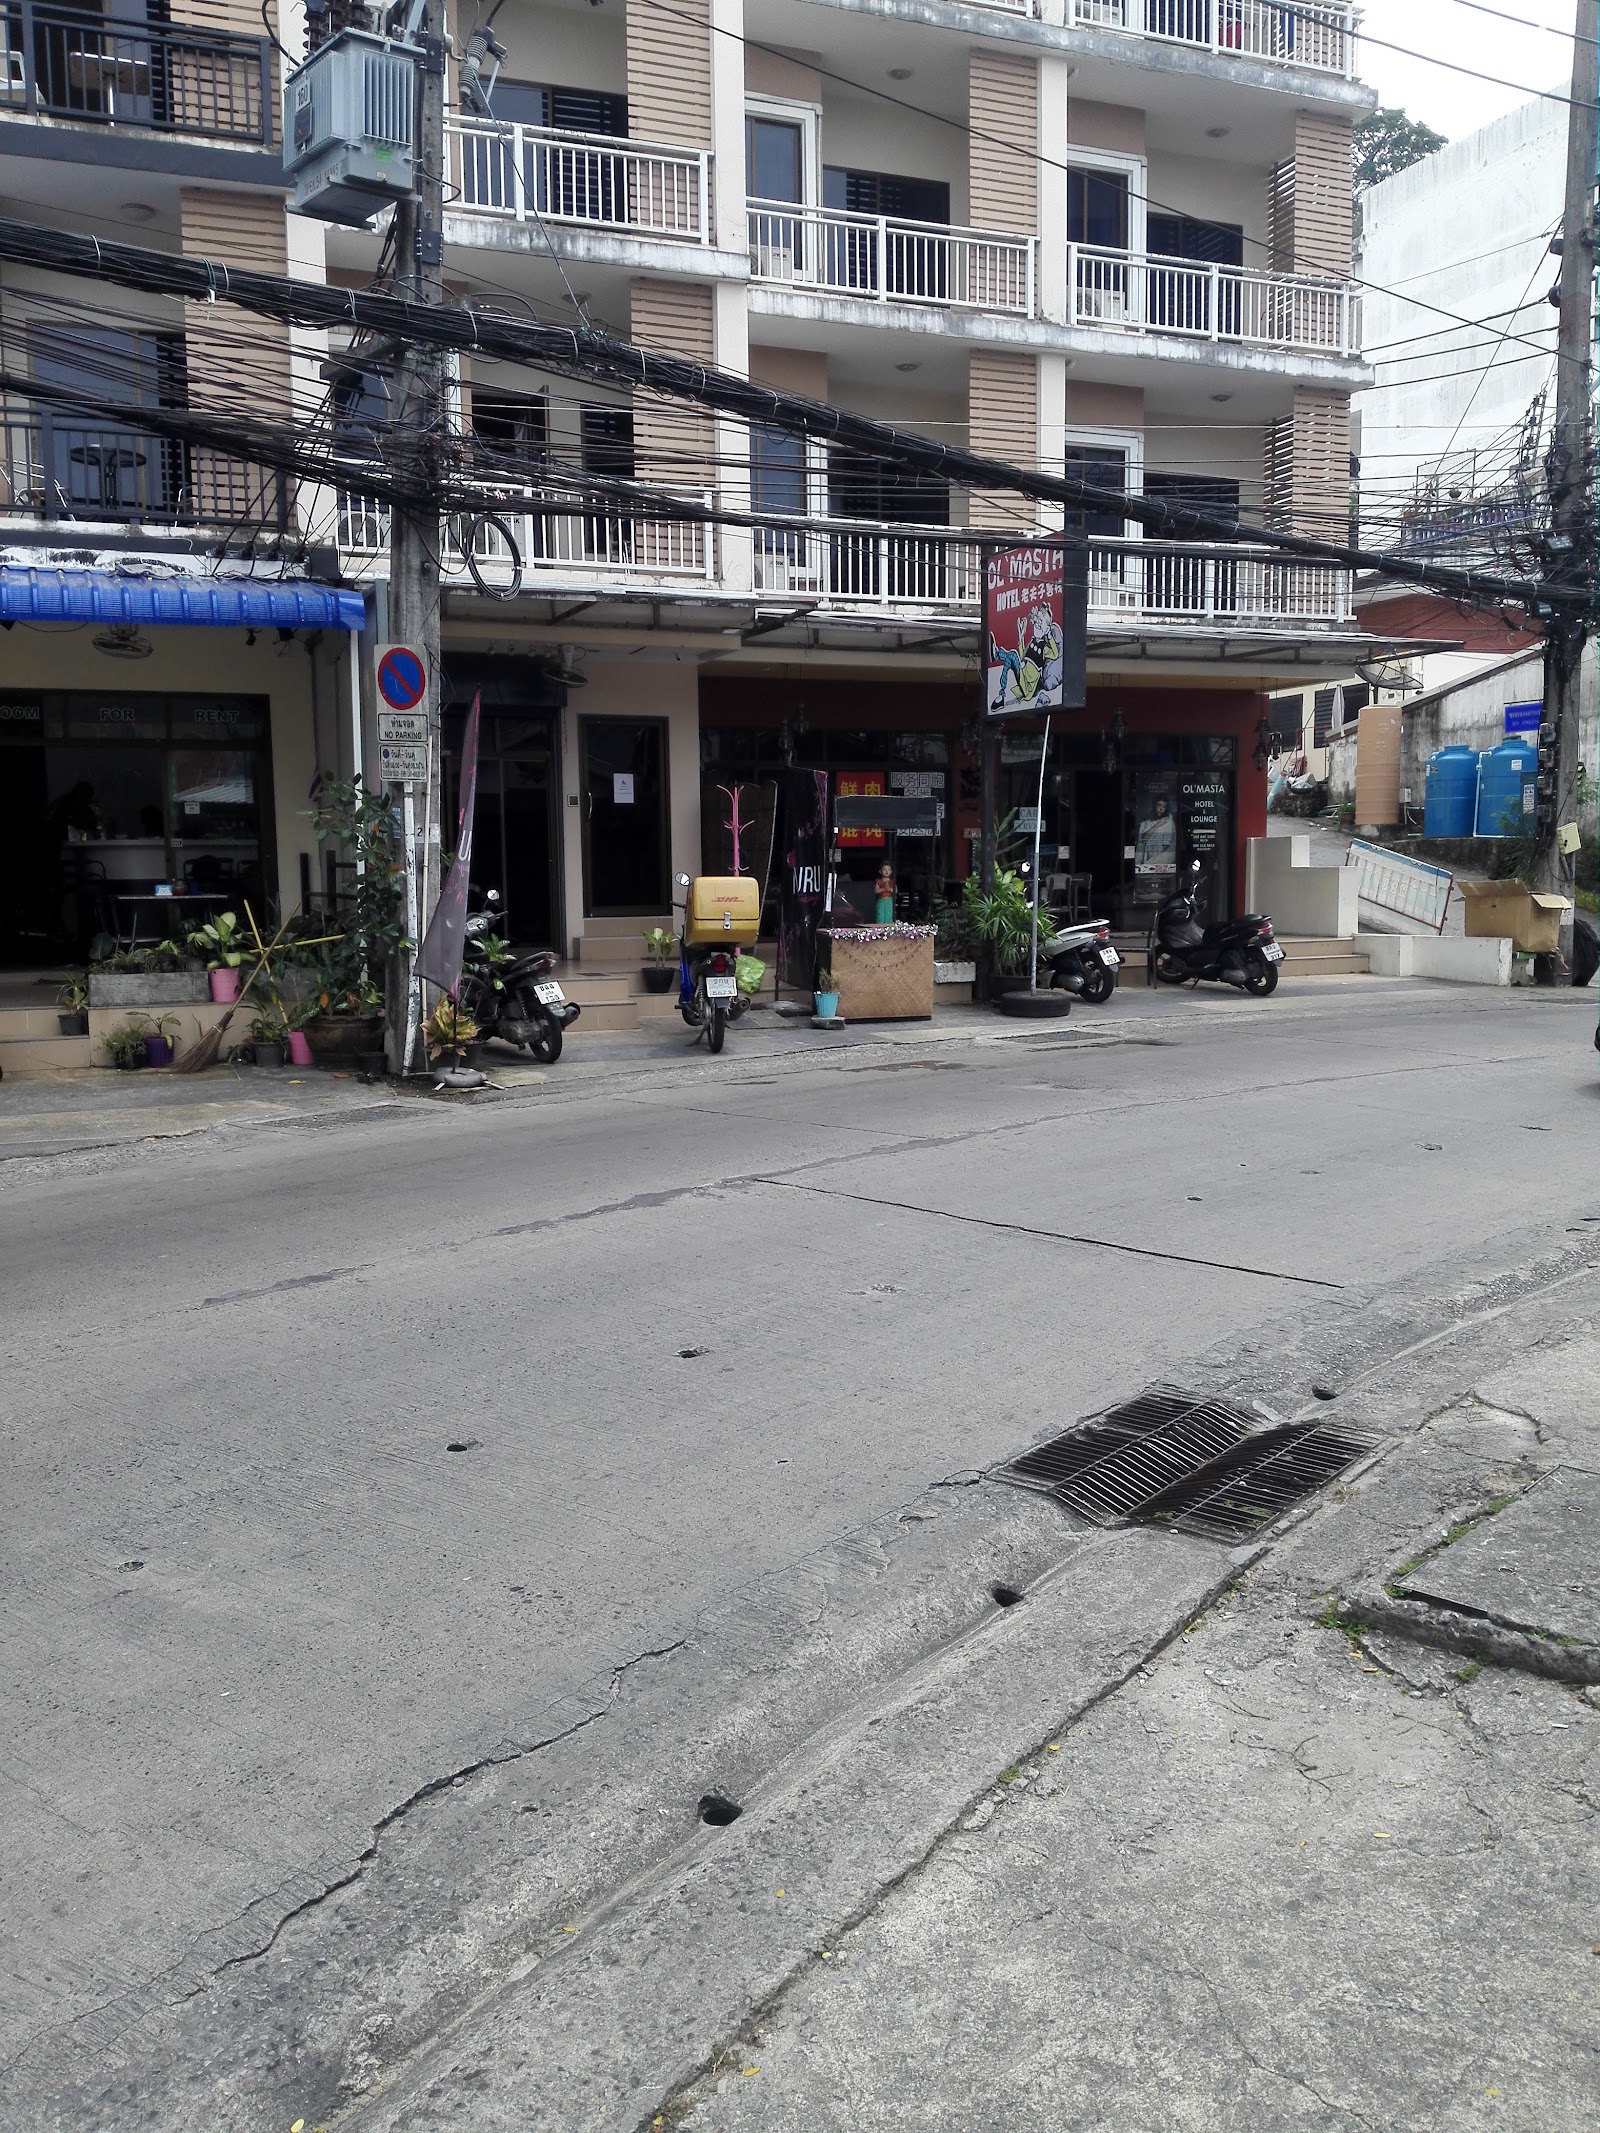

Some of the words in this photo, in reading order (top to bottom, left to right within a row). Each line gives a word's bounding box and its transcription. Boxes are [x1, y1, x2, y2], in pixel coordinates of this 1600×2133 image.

[996, 588, 1020, 612] HOTEL
[100, 708, 135, 721] FOR
[194, 709, 239, 723] RENT
[384, 731, 394, 739] NO
[395, 731, 422, 740] PARKING
[892, 773, 944, 788] 服务同胞
[1182, 784, 1225, 793] OL'MASTA
[1194, 800, 1215, 808] HOTEL
[1190, 815, 1218, 823] LOUNGE
